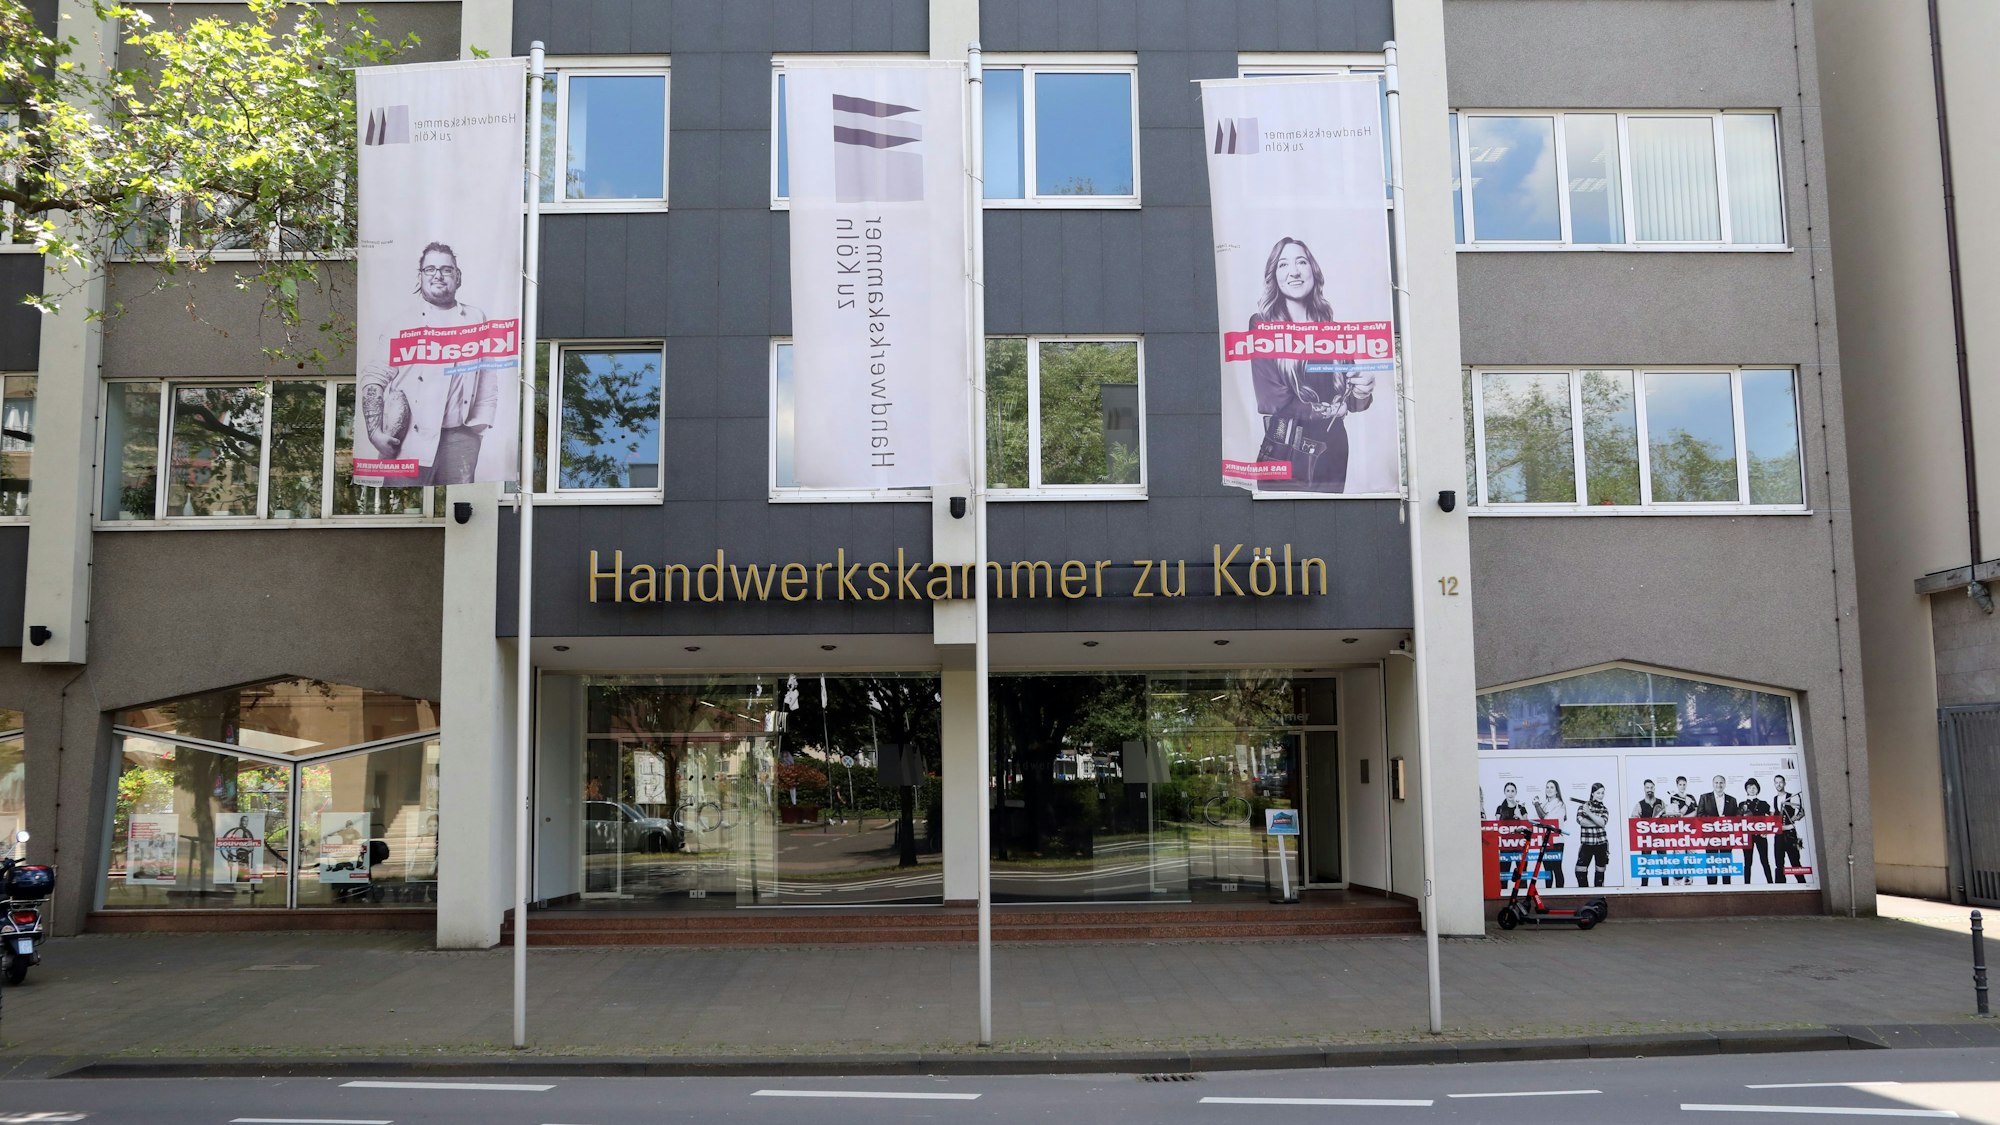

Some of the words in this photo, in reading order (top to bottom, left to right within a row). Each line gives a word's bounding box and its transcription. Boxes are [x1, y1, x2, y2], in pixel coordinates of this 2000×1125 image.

[589, 547, 1111, 603] Handwerkskammer
[1132, 559, 1185, 598] zu
[1213, 543, 1327, 598] Köln
[1437, 576, 1459, 596] 12
[1636, 820, 1697, 834] Stark,
[1701, 819, 1779, 833] stärker,
[1636, 833, 1749, 848] Handwerk!
[1637, 856, 1680, 866] Danke
[1683, 855, 1704, 865] für
[1705, 856, 1731, 864] den
[1637, 865, 1742, 876] Zusammenhalt.
